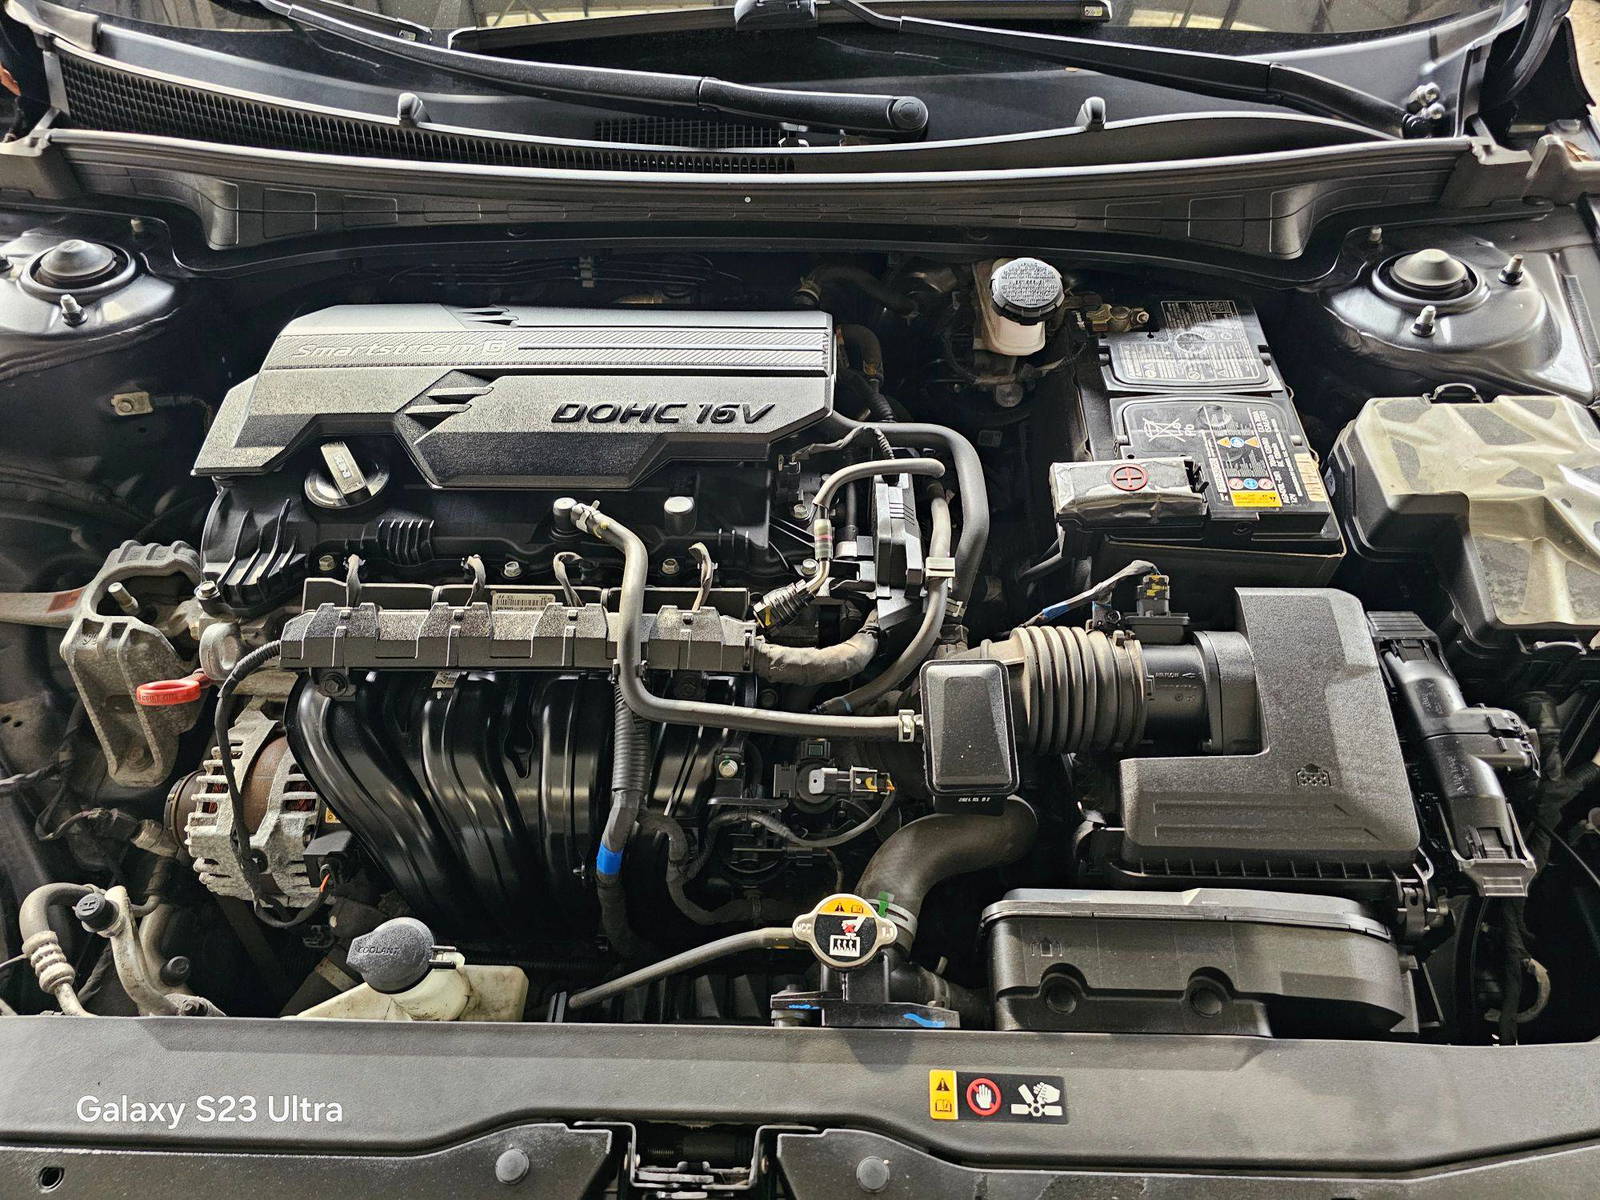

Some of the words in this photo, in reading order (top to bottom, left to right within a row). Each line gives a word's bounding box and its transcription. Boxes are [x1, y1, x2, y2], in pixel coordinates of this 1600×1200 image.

[293, 343, 476, 358] Smartstream
[550, 402, 688, 424] DOHC
[696, 402, 776, 424] 16V
[355, 945, 401, 956] COOLANT
